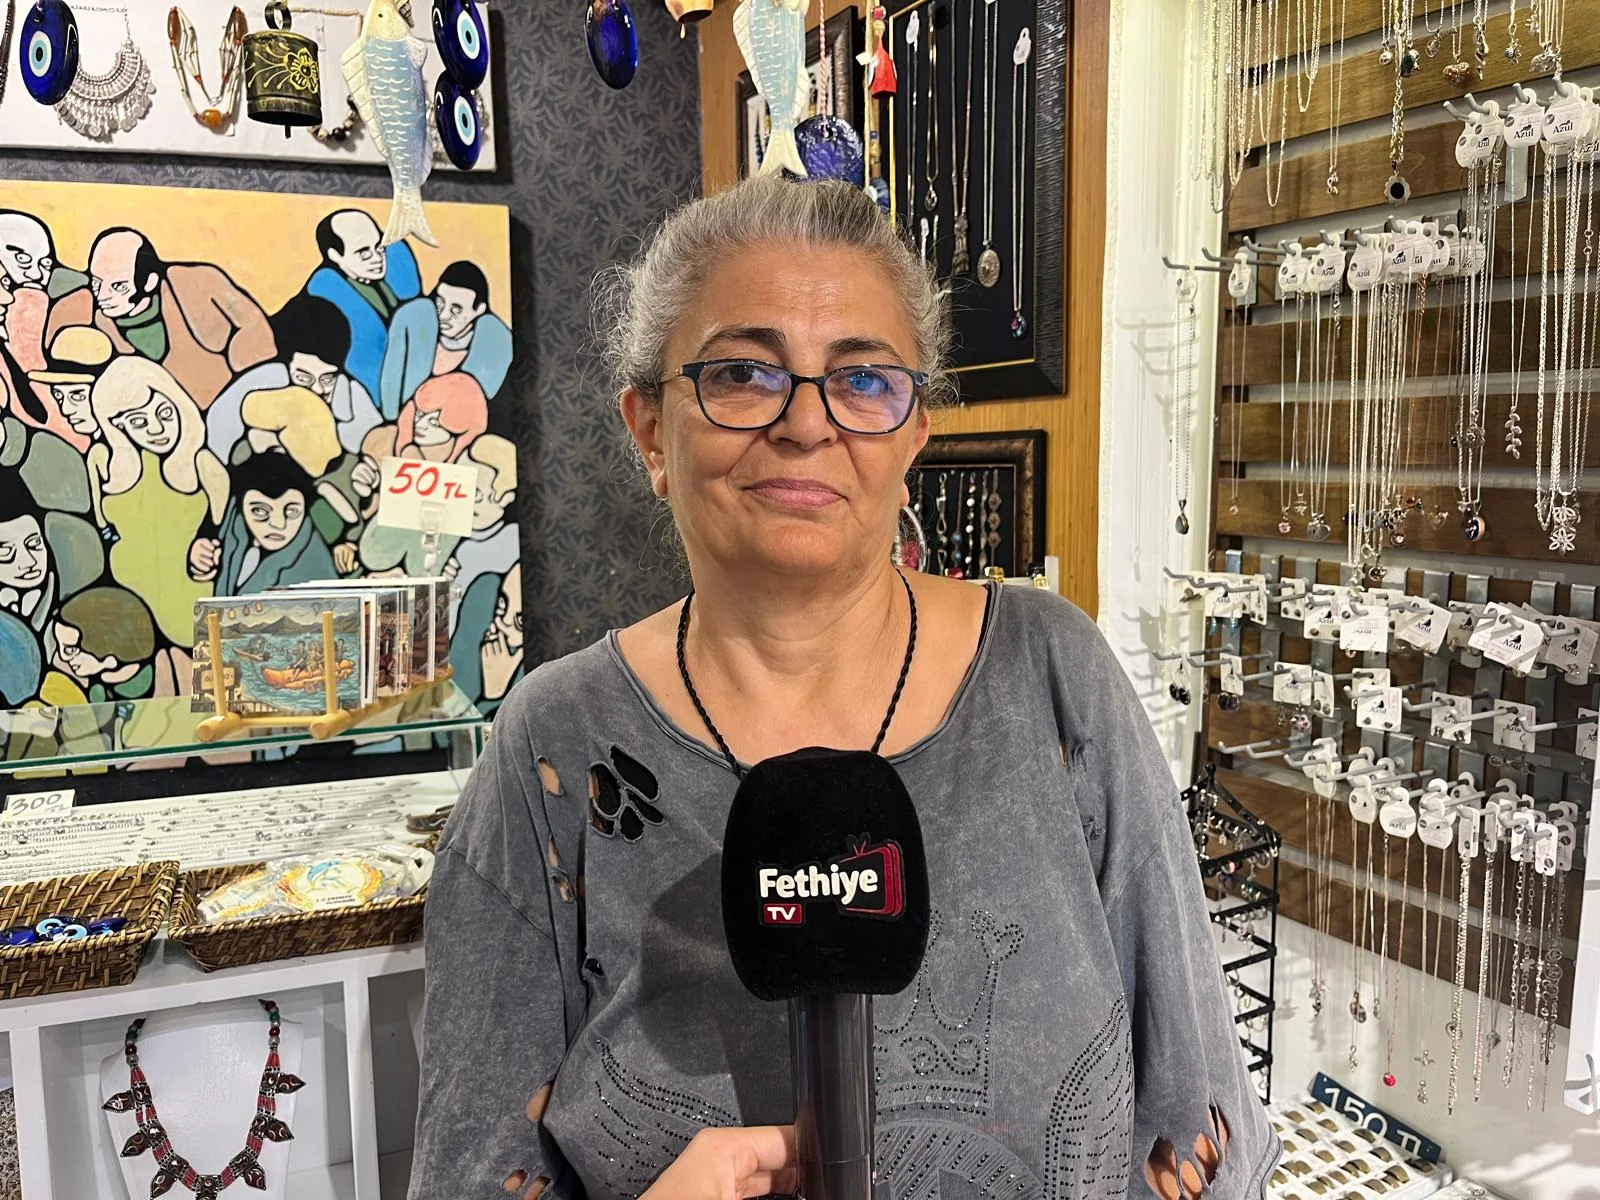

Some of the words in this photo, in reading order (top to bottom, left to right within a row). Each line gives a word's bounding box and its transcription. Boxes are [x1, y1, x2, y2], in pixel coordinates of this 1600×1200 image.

[1513, 127, 1534, 140] Azul
[1552, 121, 1574, 135] Azul
[1475, 138, 1490, 150] Azul
[388, 462, 440, 497] 50
[444, 482, 468, 499] TL
[1503, 638, 1523, 651] Azul
[1561, 643, 1579, 657] Azul
[11, 793, 62, 817] 300
[759, 864, 878, 905] Fethiye
[767, 906, 796, 921] TV
[1324, 1087, 1388, 1138] 150
